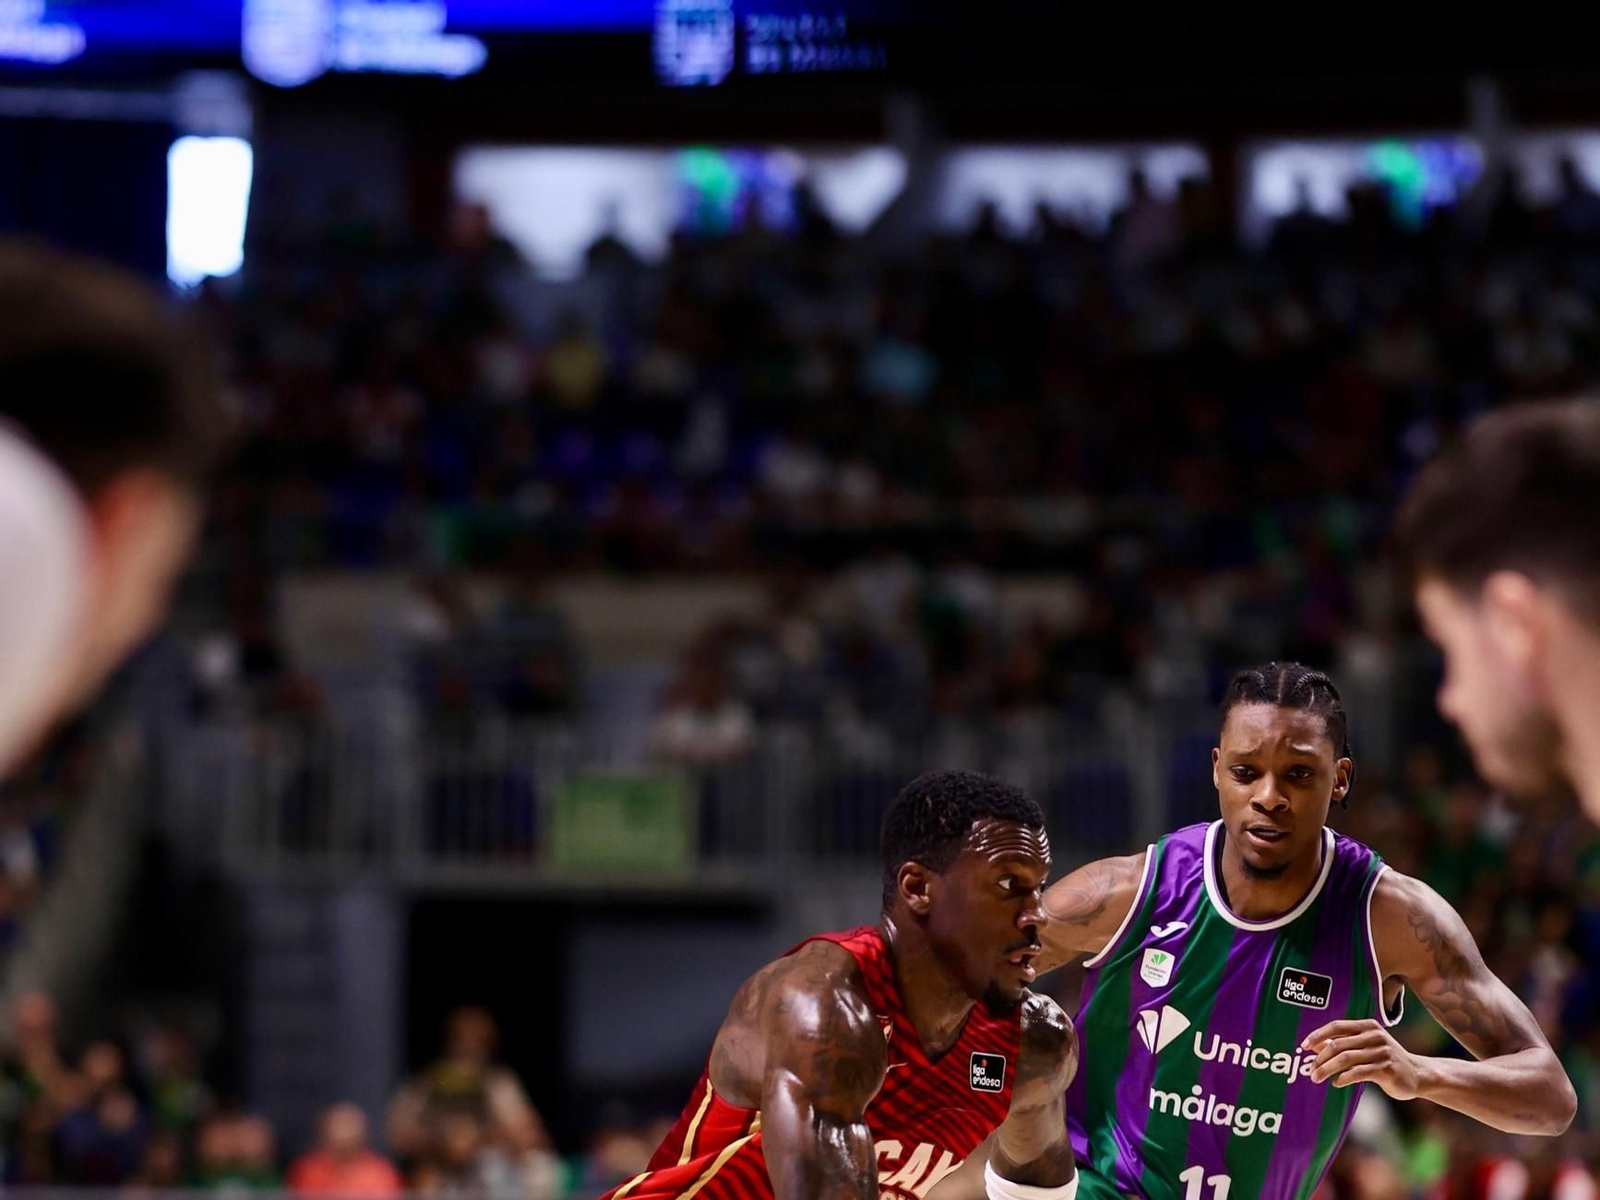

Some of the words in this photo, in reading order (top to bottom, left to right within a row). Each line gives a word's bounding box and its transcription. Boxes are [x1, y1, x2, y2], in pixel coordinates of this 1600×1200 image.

[1284, 978, 1305, 991] liga
[1282, 989, 1325, 1005] endesa
[1193, 1031, 1317, 1084] Unicaja
[972, 1064, 986, 1076] liga
[972, 1076, 1001, 1087] endesa
